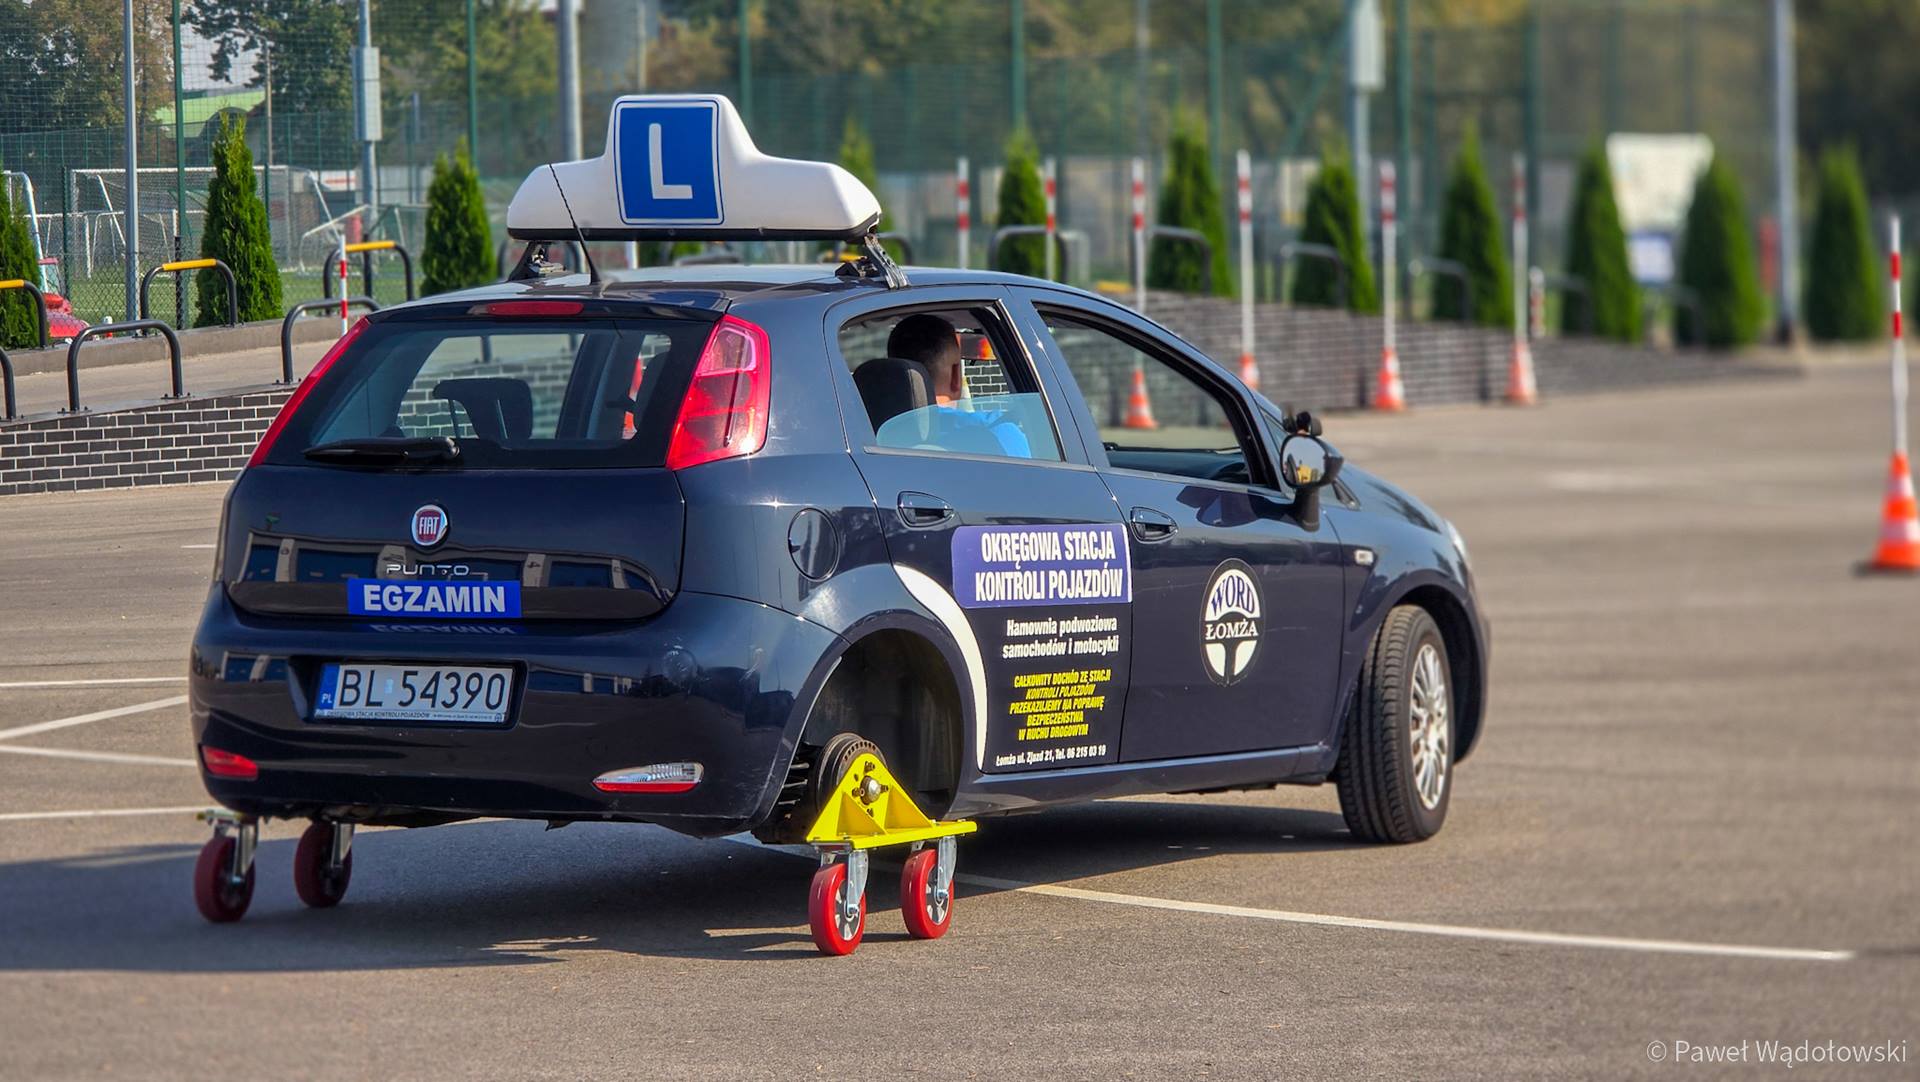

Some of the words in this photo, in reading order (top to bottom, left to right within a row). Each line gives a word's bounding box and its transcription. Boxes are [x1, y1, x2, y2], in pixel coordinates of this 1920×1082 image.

[649, 123, 693, 200] L
[418, 516, 439, 535] FIAT
[981, 532, 1062, 569] OKRĘGOWA
[1064, 531, 1116, 560] STACJA
[386, 564, 470, 576] PUNTO
[975, 570, 1045, 601] KONTROLI
[1049, 562, 1123, 599] POJAZDÓW
[363, 584, 506, 613] EGZAMIN
[1211, 575, 1255, 616] WORD
[1007, 617, 1057, 636] Hamownia
[1059, 615, 1117, 637] podwoziowa
[1205, 618, 1259, 640] ŁOMŻA
[1002, 638, 1066, 659] samochodów
[1068, 638, 1073, 654] i
[1074, 635, 1119, 656] motocykli
[1052, 669, 1079, 685] DOCHÓD
[1080, 670, 1089, 683] ZE
[1088, 669, 1111, 682] STACJI
[321, 693, 332, 703] PL
[338, 669, 383, 707] BL
[398, 670, 506, 710] 54390
[1026, 686, 1060, 700] KONTROLI
[1059, 682, 1096, 697] POJAZDÓW
[1009, 699, 1062, 714] PRZEKAZUJEMY
[1062, 698, 1072, 710] NA
[1073, 695, 1105, 711] POPRAWĘ
[1027, 710, 1084, 726] BEZPIECZEŃSTWA
[1018, 729, 1026, 741] W
[1026, 727, 1049, 740] RUCHU
[1050, 724, 1089, 738] DROGOWYM
[1075, 746, 1088, 758] 215
[1088, 745, 1097, 757] 03
